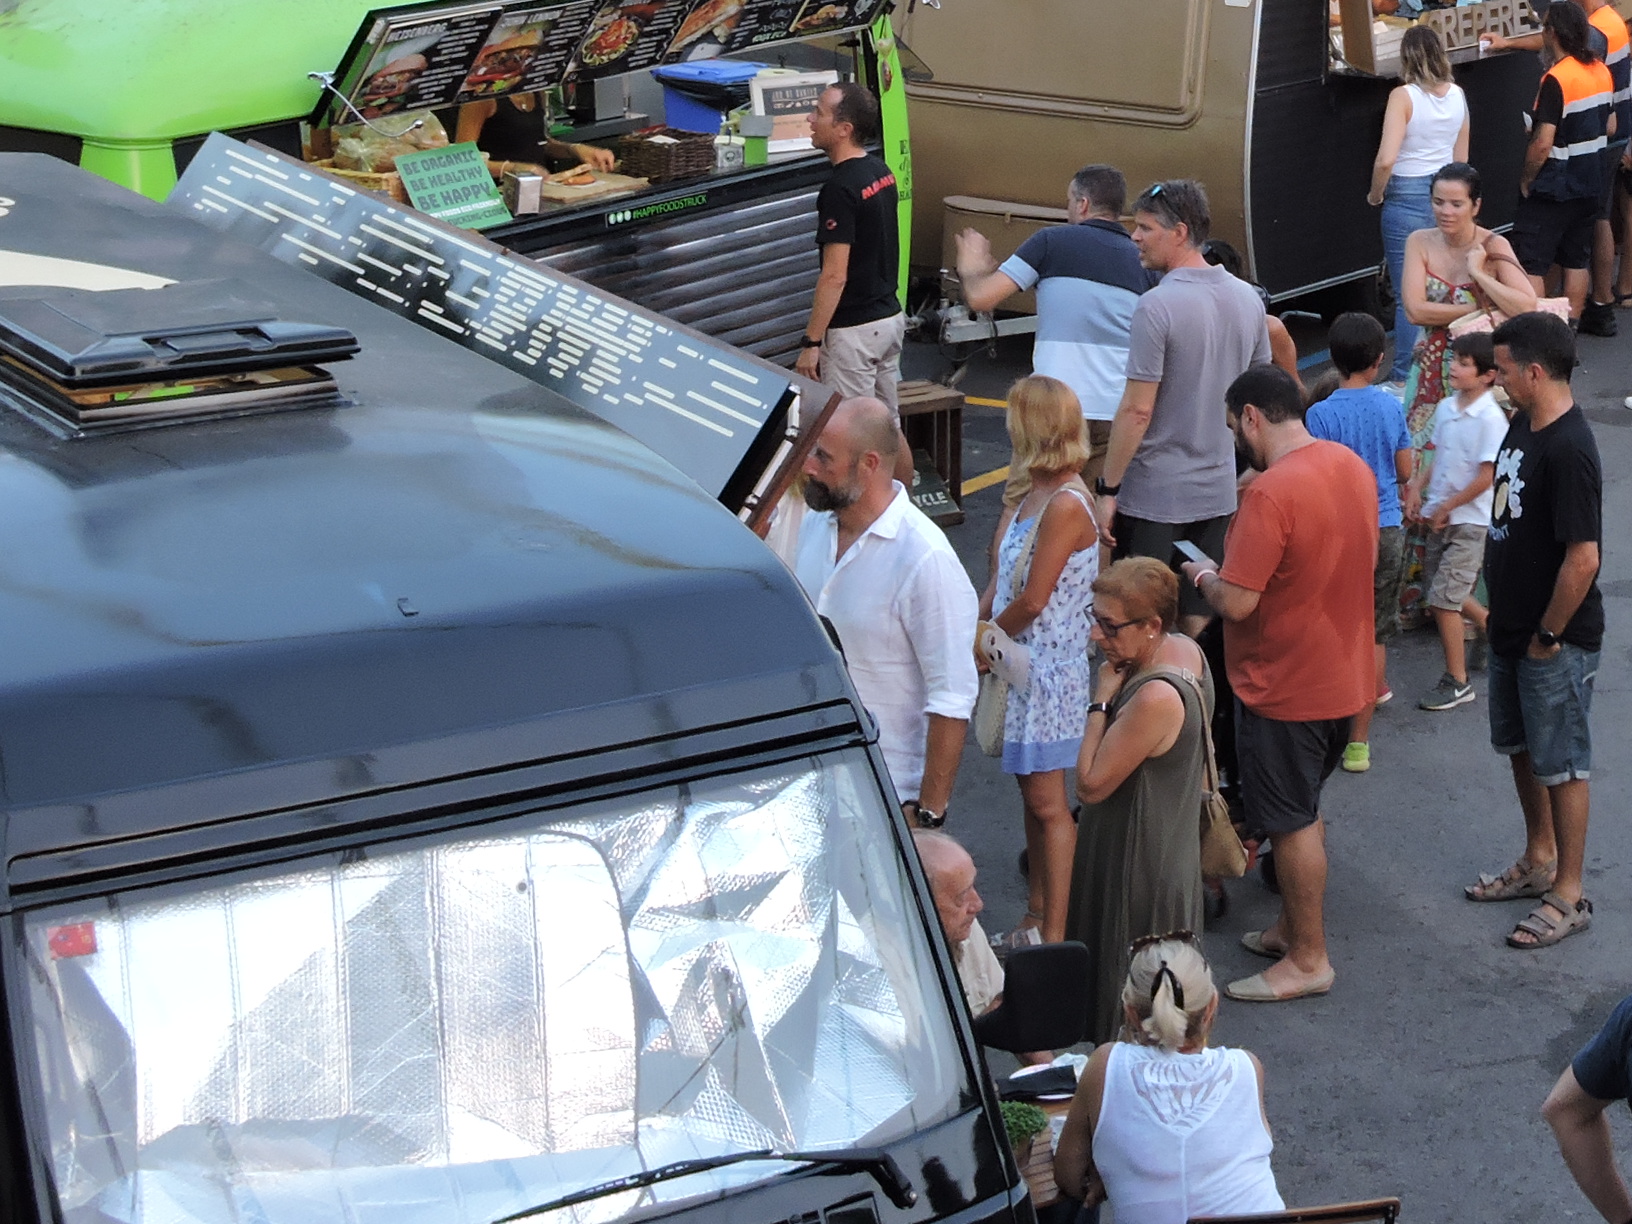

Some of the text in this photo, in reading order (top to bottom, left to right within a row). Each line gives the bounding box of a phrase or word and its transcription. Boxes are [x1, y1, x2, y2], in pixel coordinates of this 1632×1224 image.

[402, 149, 478, 176] BE ORGANIC
[409, 165, 483, 192] BE HEALTHY
[417, 181, 492, 211] BE HAPPY
[632, 194, 708, 219] #HAPPYFOODSTRUCK
